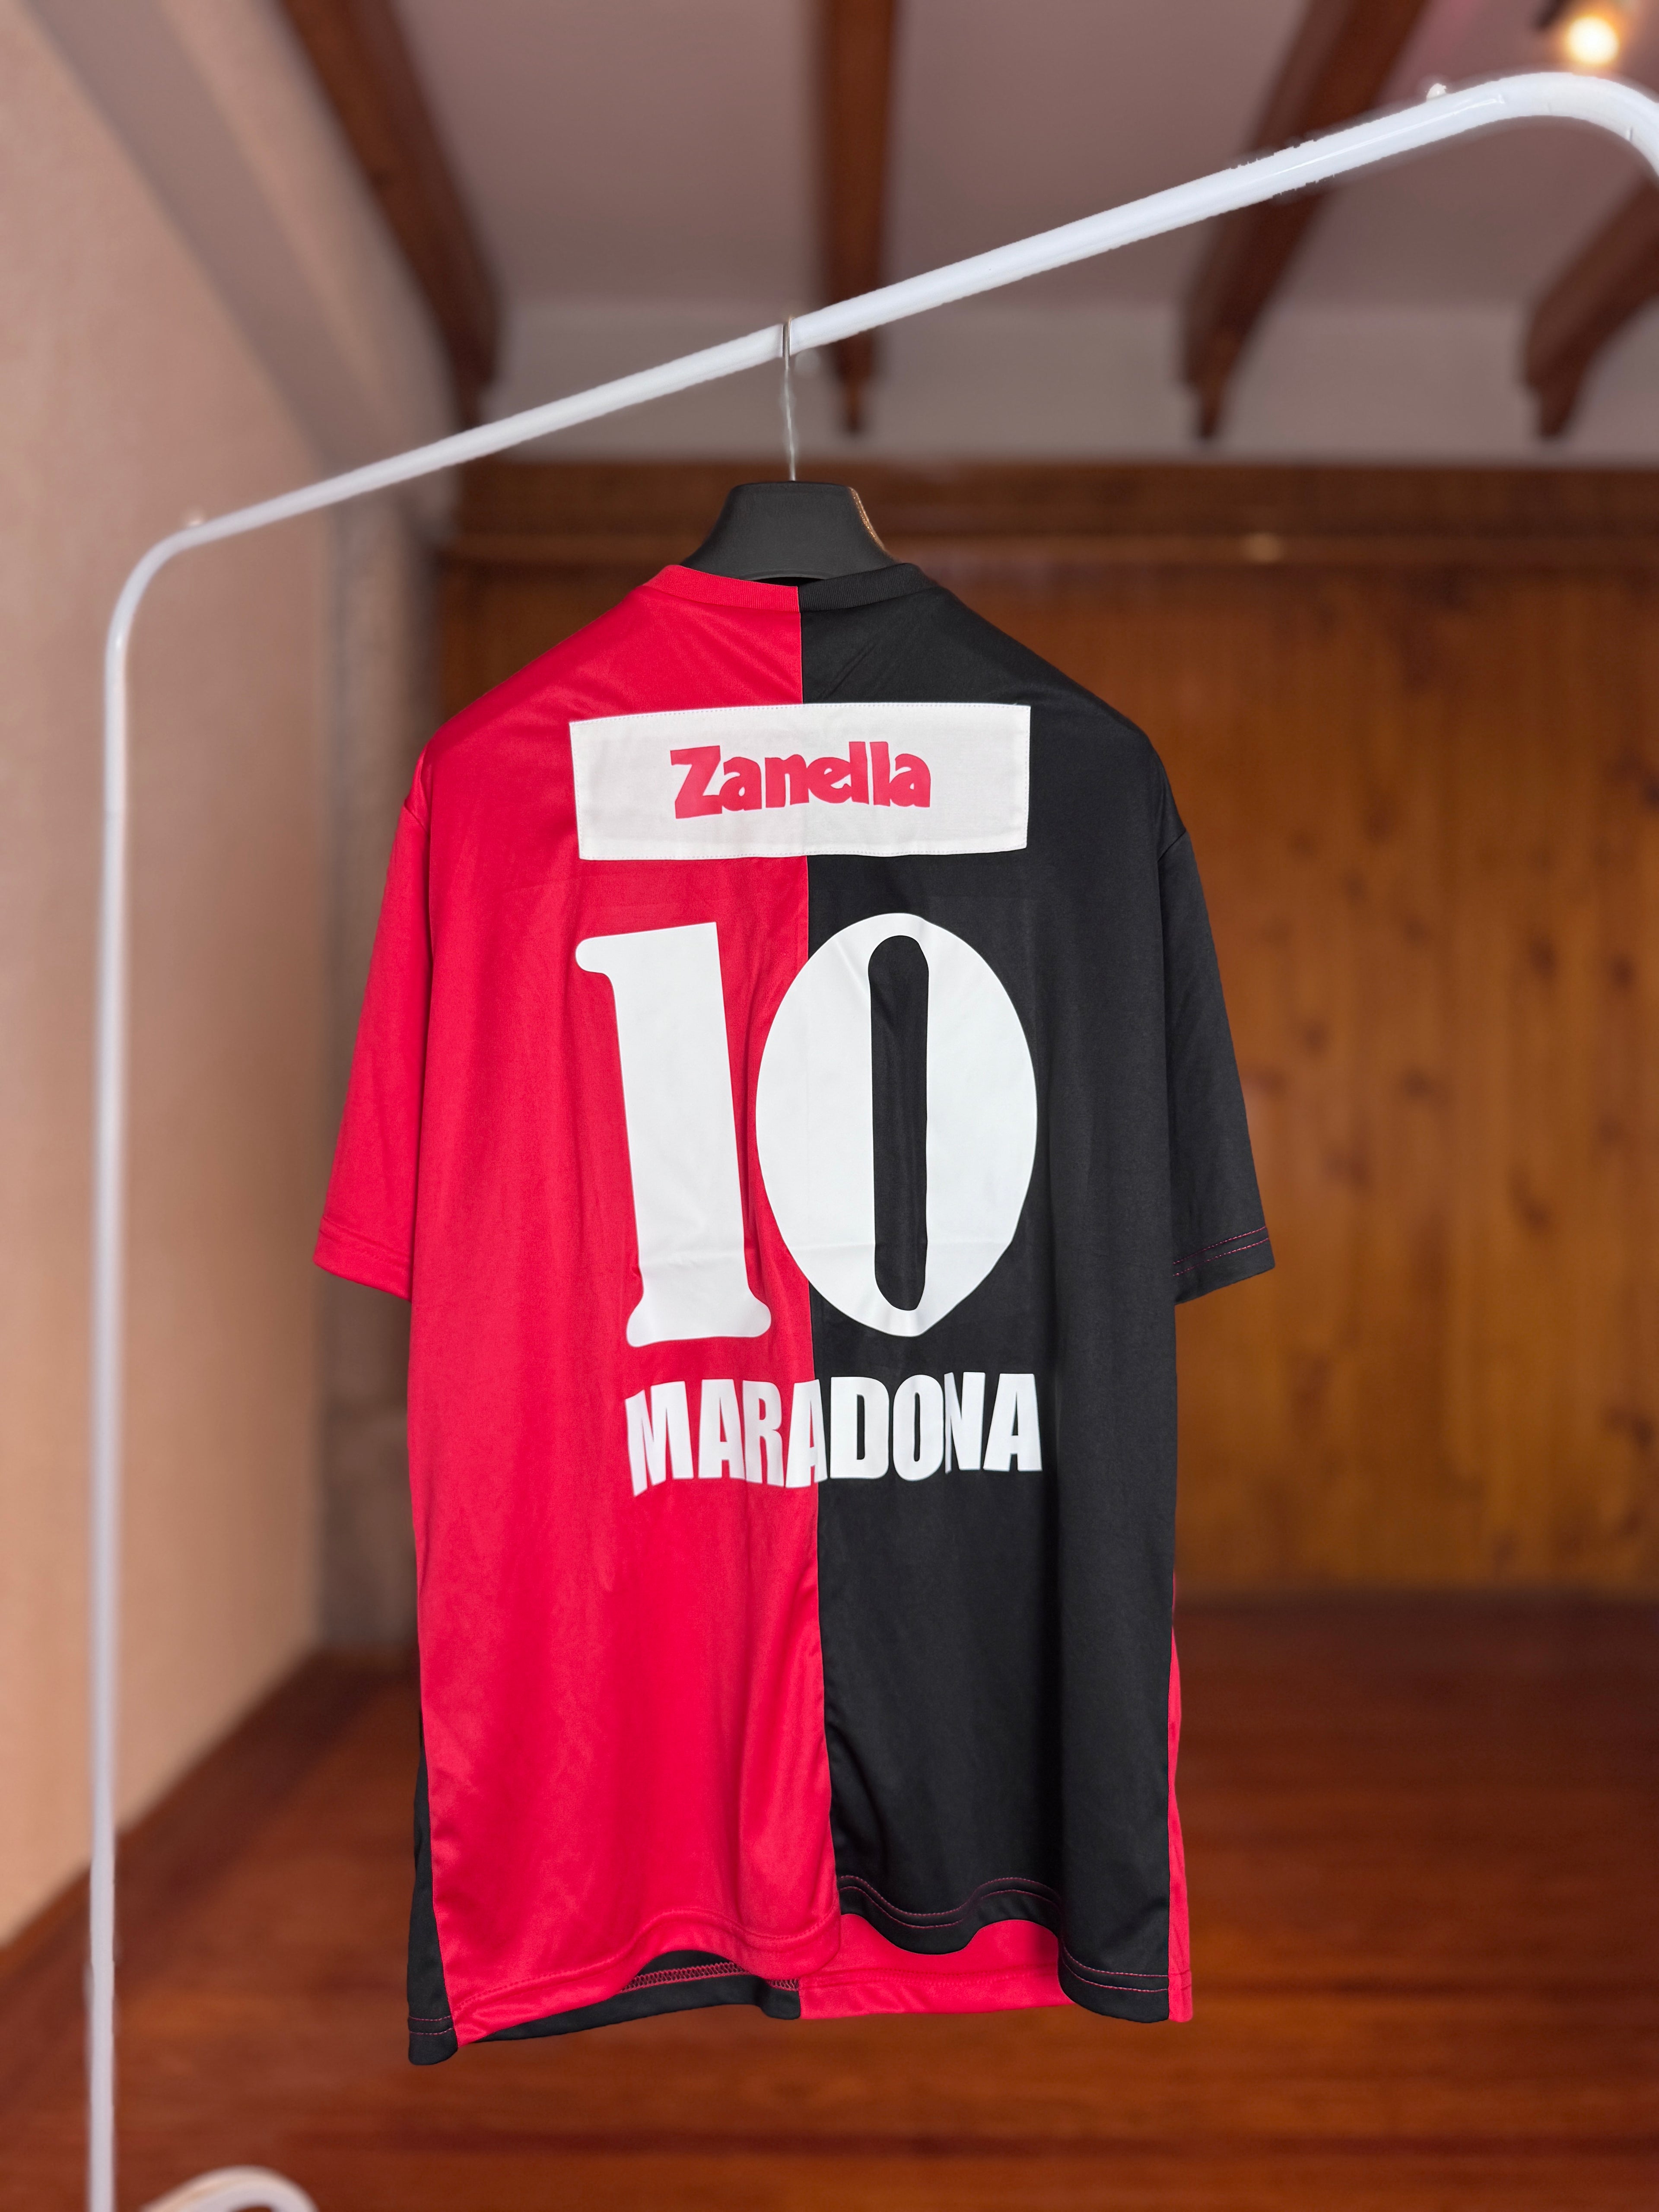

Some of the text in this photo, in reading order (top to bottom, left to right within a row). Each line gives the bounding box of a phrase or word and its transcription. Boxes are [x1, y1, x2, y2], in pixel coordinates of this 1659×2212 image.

[670, 741, 931, 819] Zanella
[575, 912, 1038, 1348] 10
[625, 1372, 1042, 1496] MARADONA
